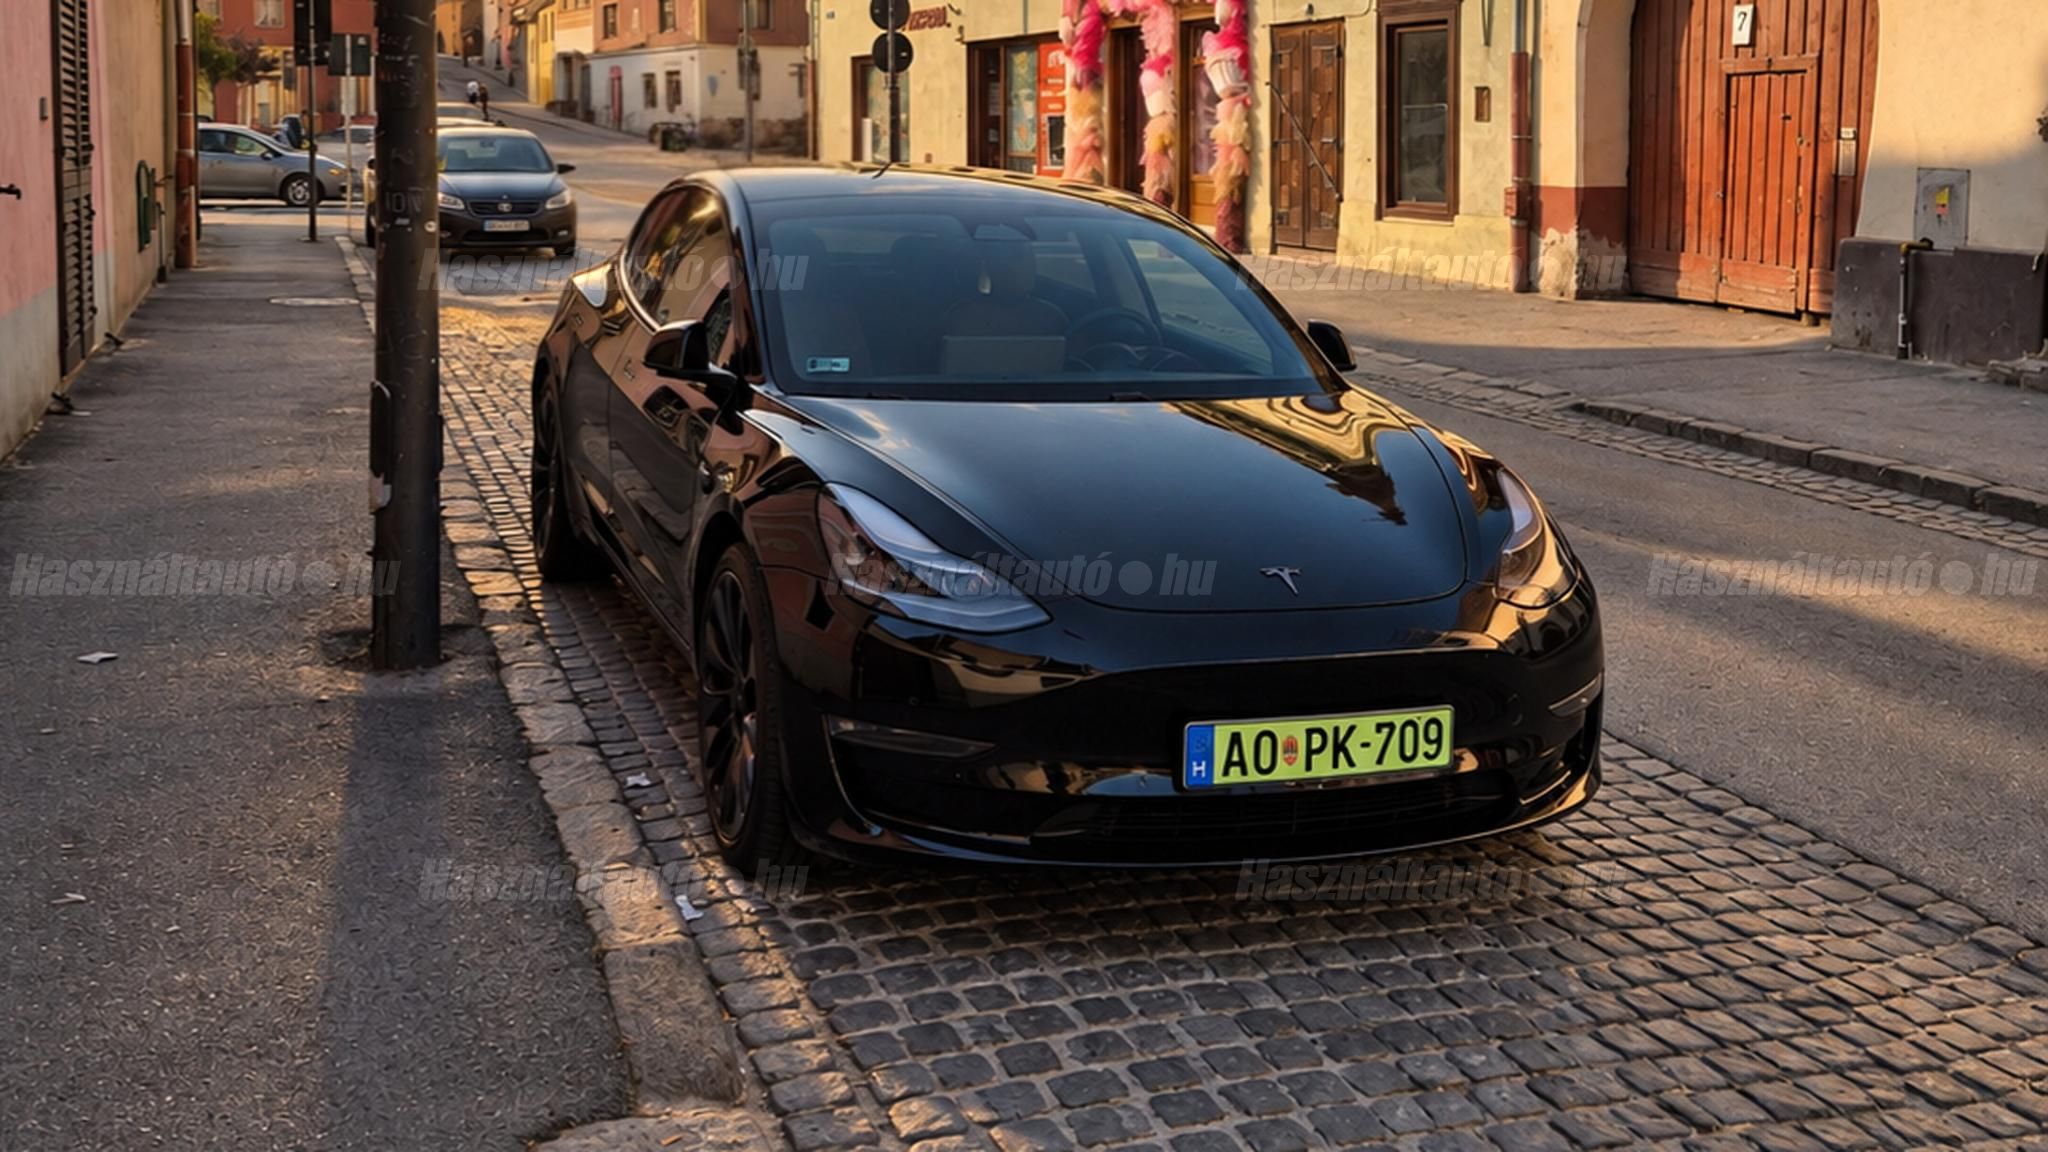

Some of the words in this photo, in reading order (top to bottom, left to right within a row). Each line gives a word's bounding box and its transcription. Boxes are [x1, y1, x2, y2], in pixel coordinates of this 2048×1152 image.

[1737, 11, 1747, 32] 7
[1222, 730, 1278, 777] AO
[1305, 717, 1444, 772] PK-709
[1193, 760, 1206, 777] H
